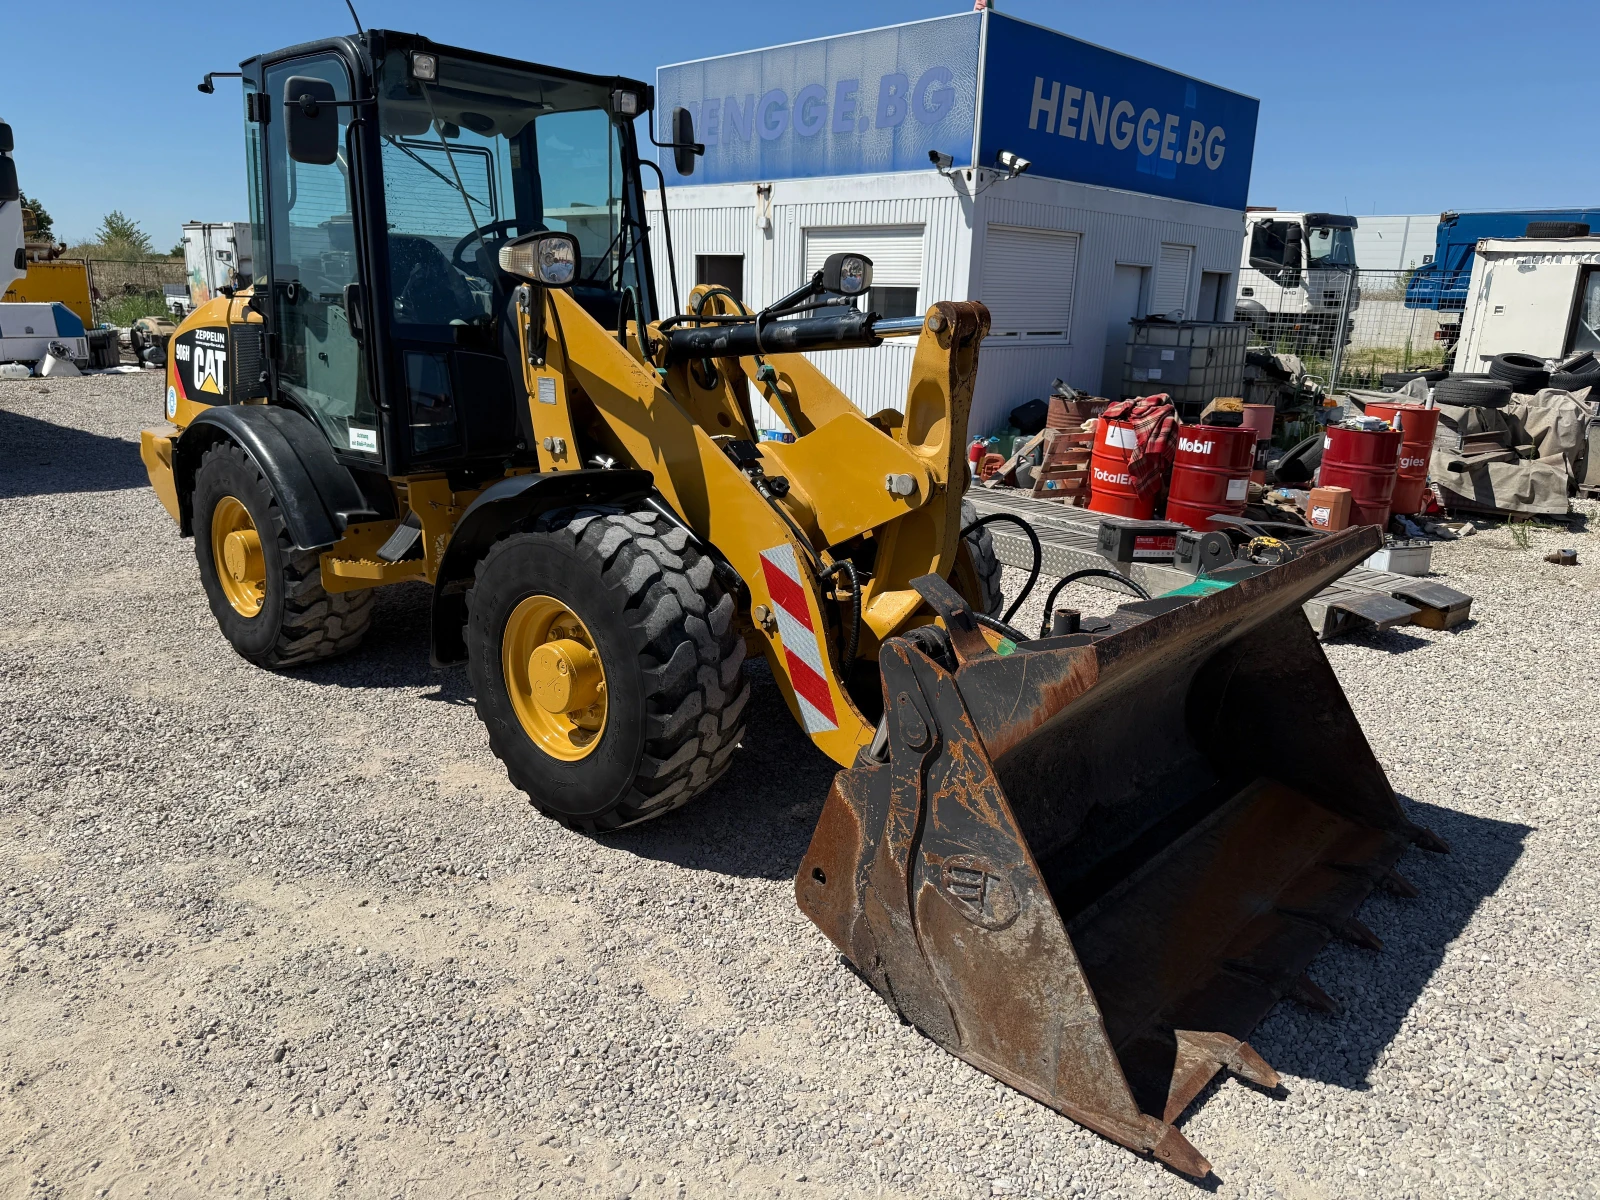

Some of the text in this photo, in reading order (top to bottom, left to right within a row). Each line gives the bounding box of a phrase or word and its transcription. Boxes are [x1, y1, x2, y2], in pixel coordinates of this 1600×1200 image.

[1028, 76, 1226, 171] HENGGE.BG
[195, 329, 225, 344] ZEPPELIN
[176, 344, 191, 362] 906H
[193, 346, 227, 396] CAT
[1178, 437, 1213, 455] Mobil
